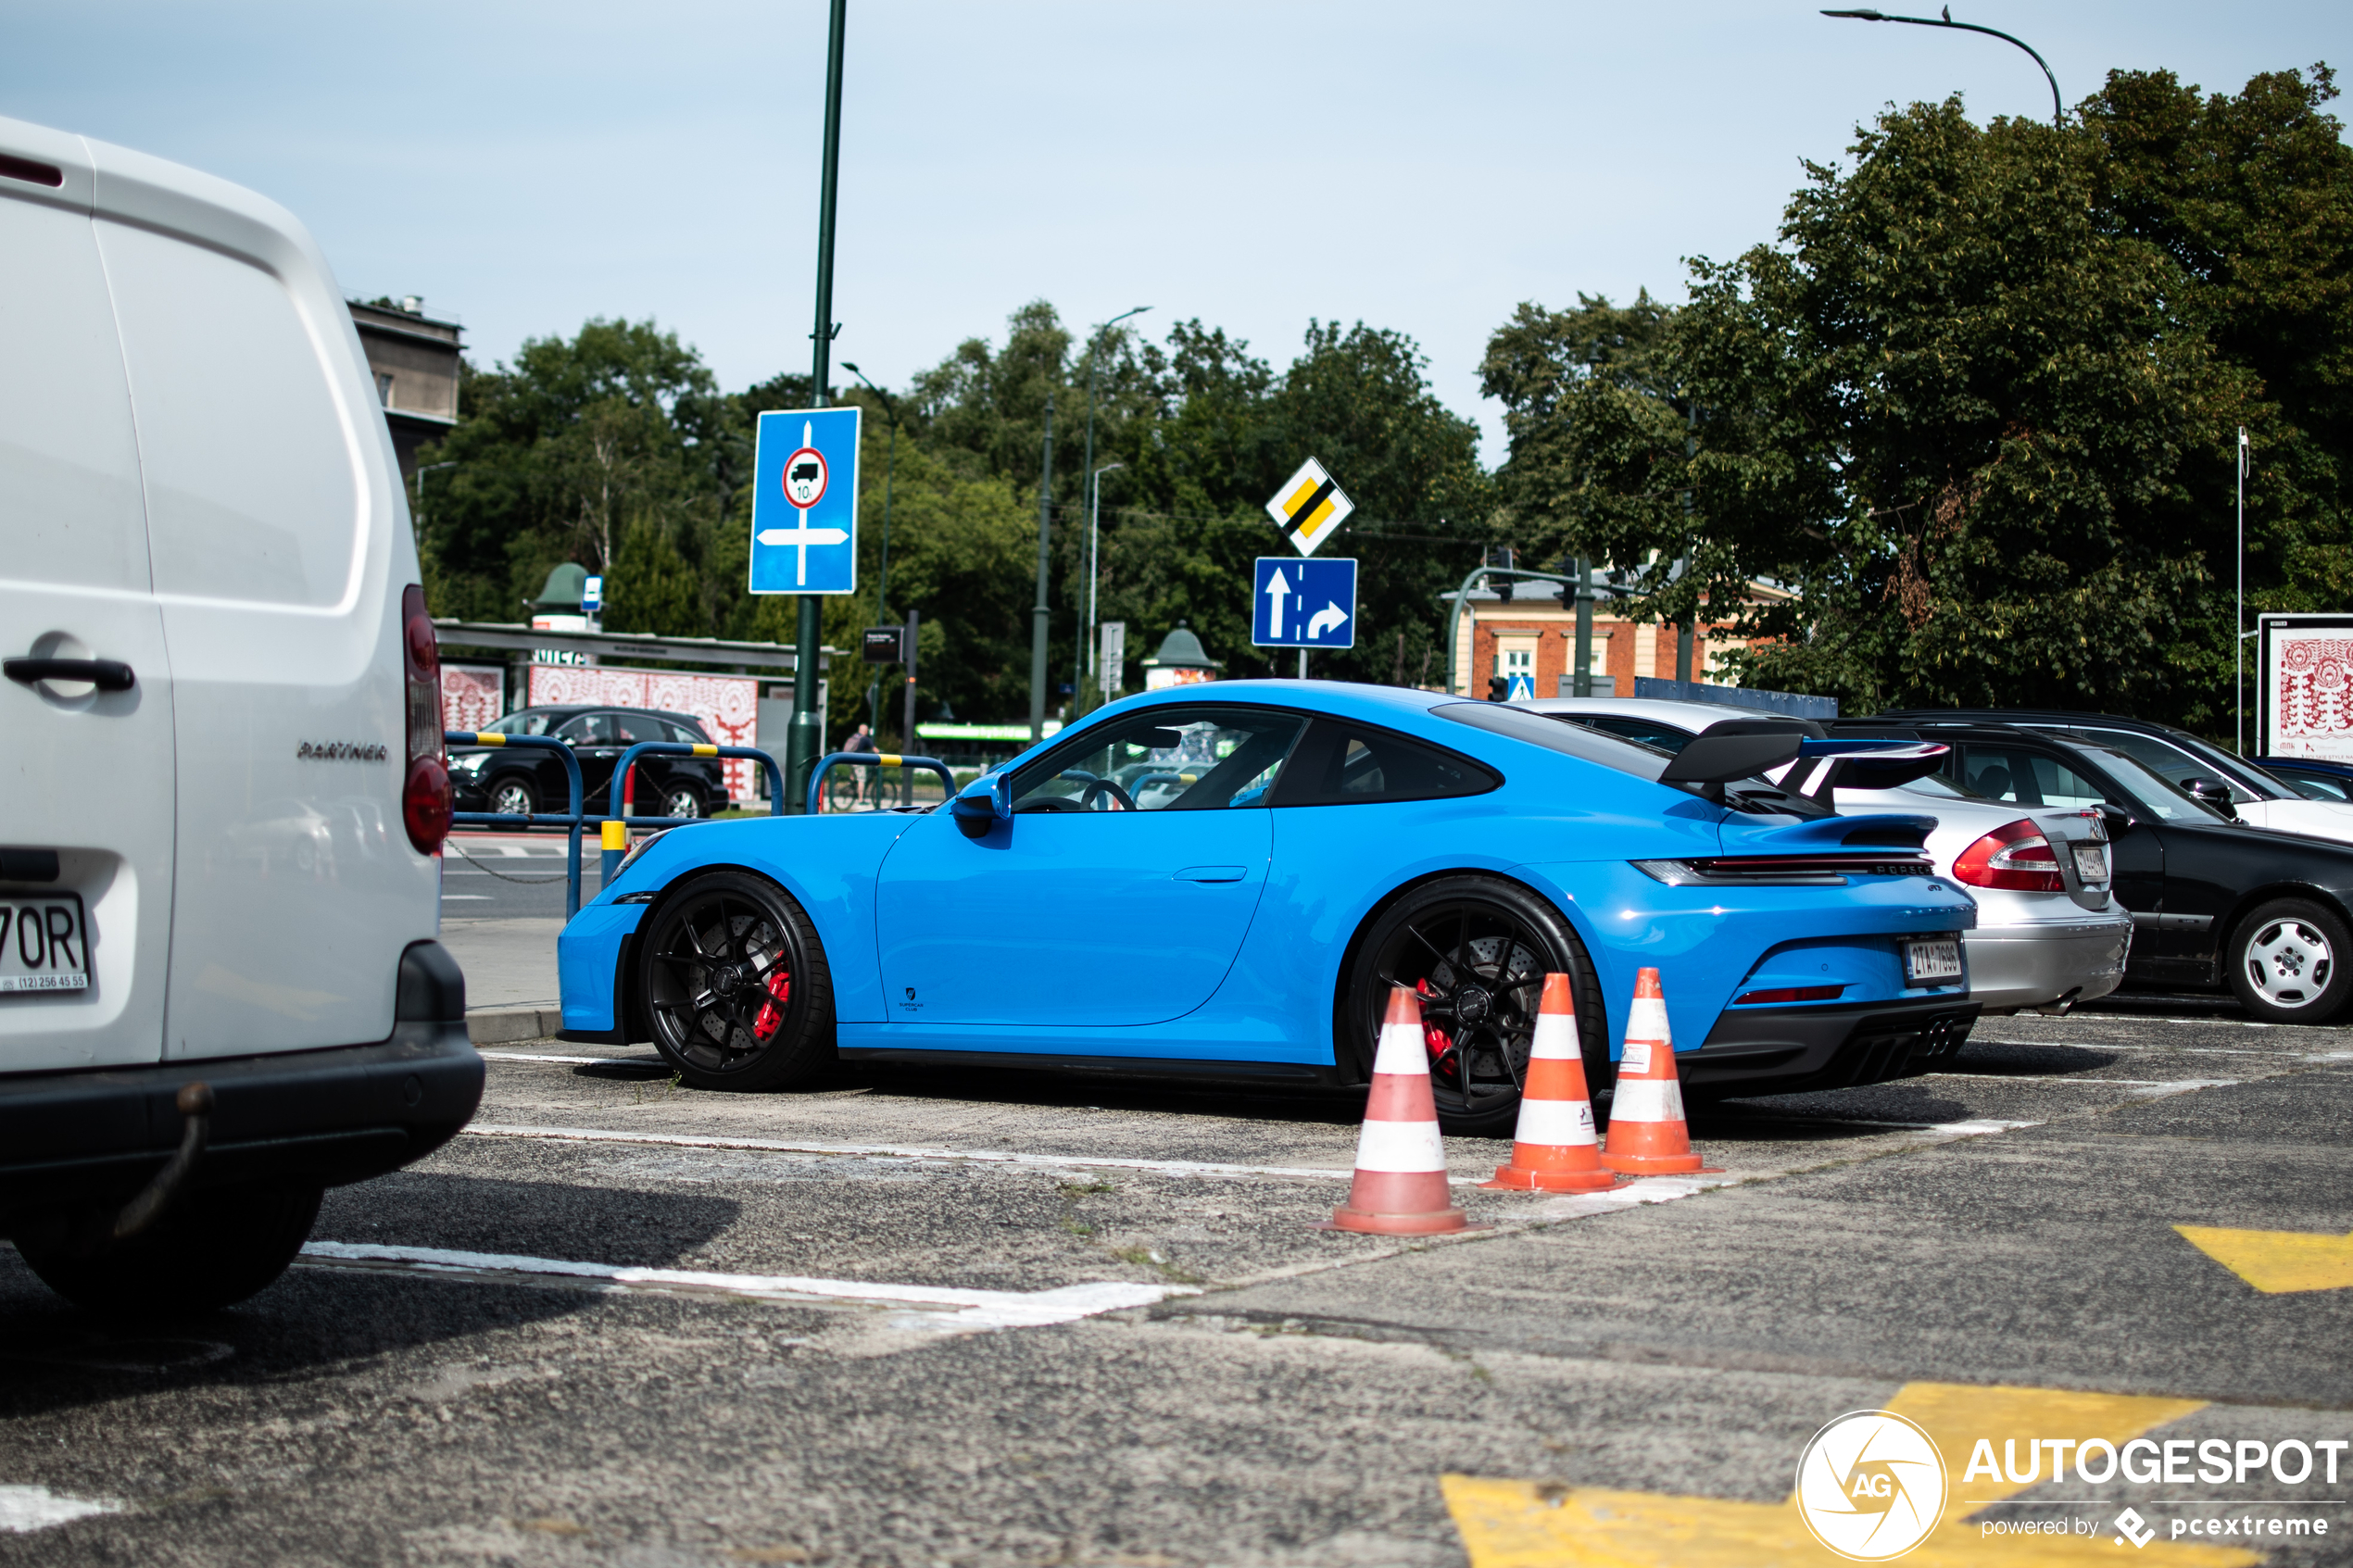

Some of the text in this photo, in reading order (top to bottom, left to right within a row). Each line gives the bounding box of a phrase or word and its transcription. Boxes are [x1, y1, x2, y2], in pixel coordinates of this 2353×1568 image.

[980, 726, 1014, 738] hybrid
[296, 740, 387, 760] PARTNER
[1877, 865, 1934, 875] PORSCHE
[1912, 944, 1957, 974] 2TA 7696
[19, 975, 84, 988] (12) 256 45 55
